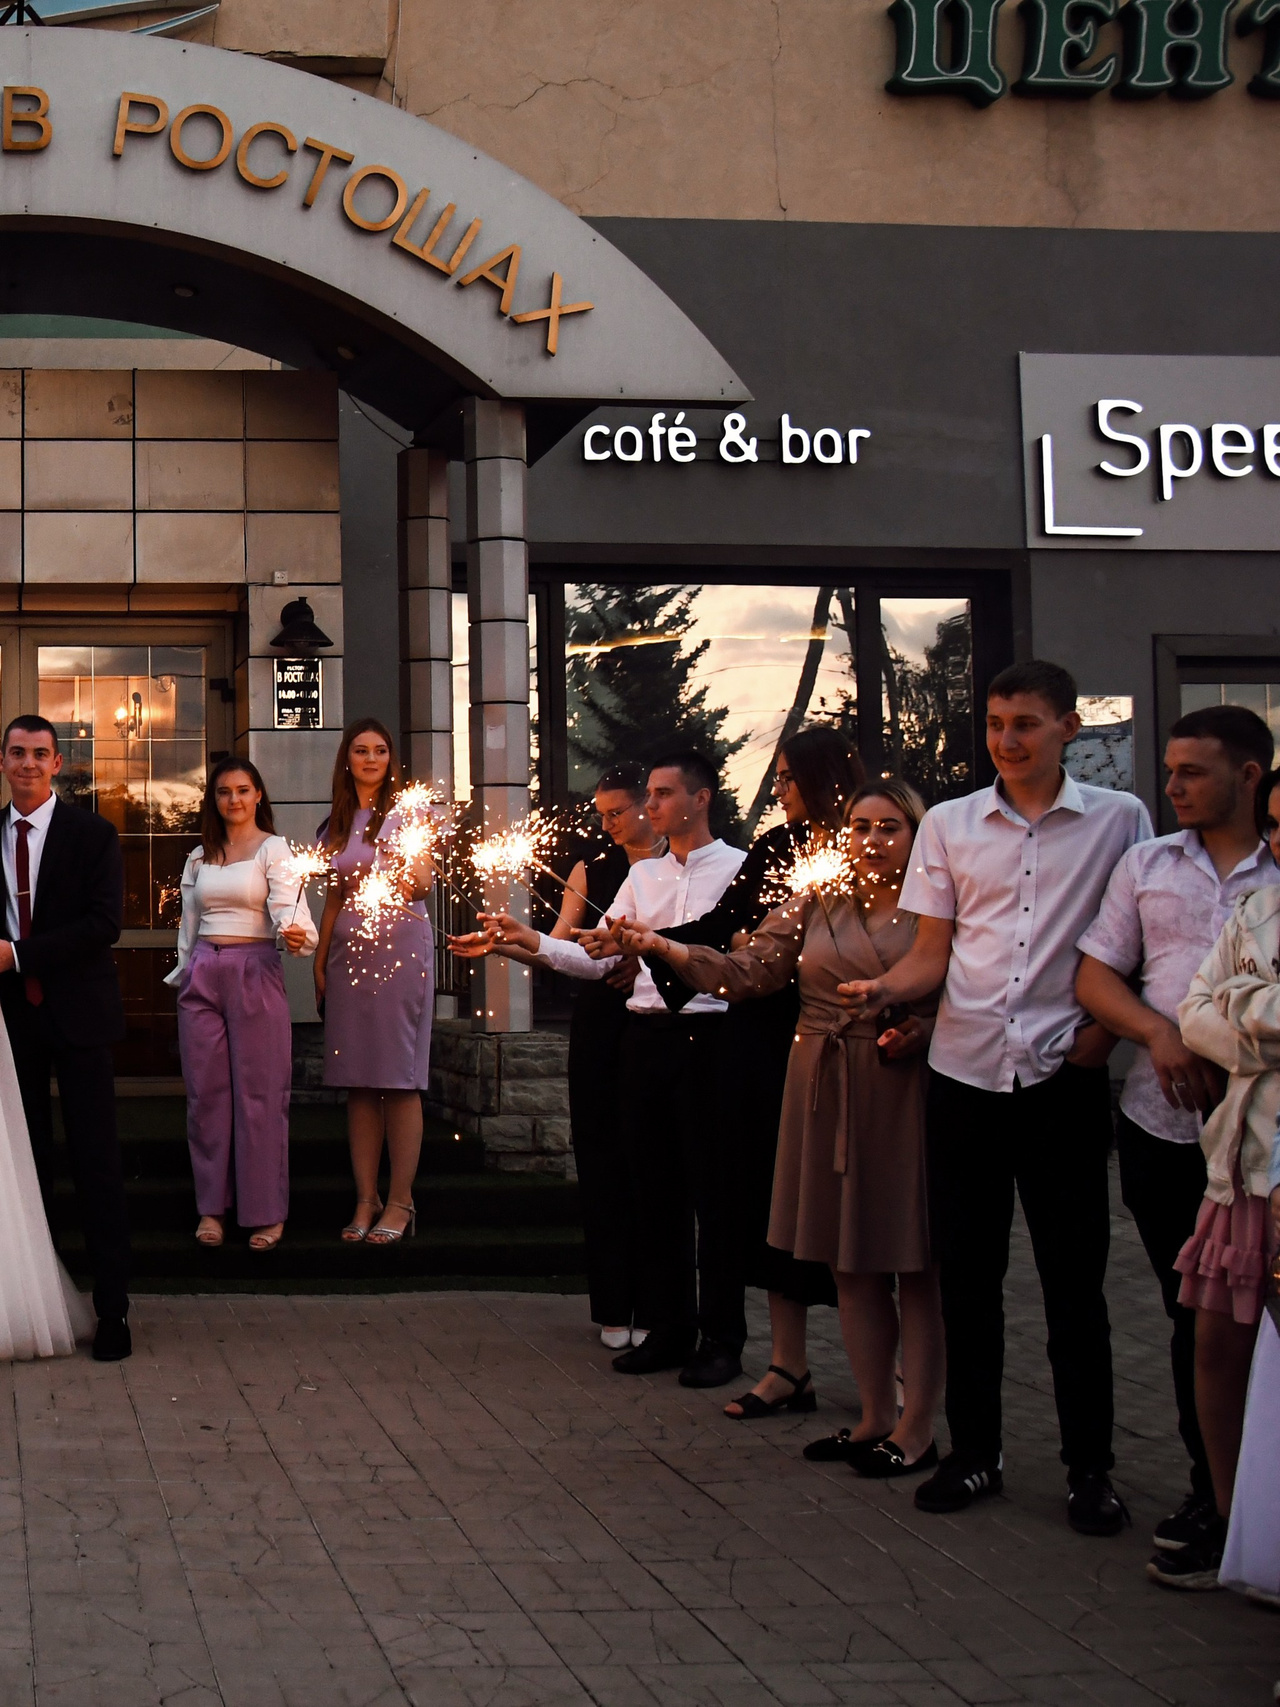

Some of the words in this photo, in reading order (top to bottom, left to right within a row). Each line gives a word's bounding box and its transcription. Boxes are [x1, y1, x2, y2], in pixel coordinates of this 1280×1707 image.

[2, 86, 53, 152] В
[112, 92, 595, 357] РОСТОШАХ
[584, 412, 697, 463] café
[719, 413, 759, 463] &
[782, 414, 871, 464] bar
